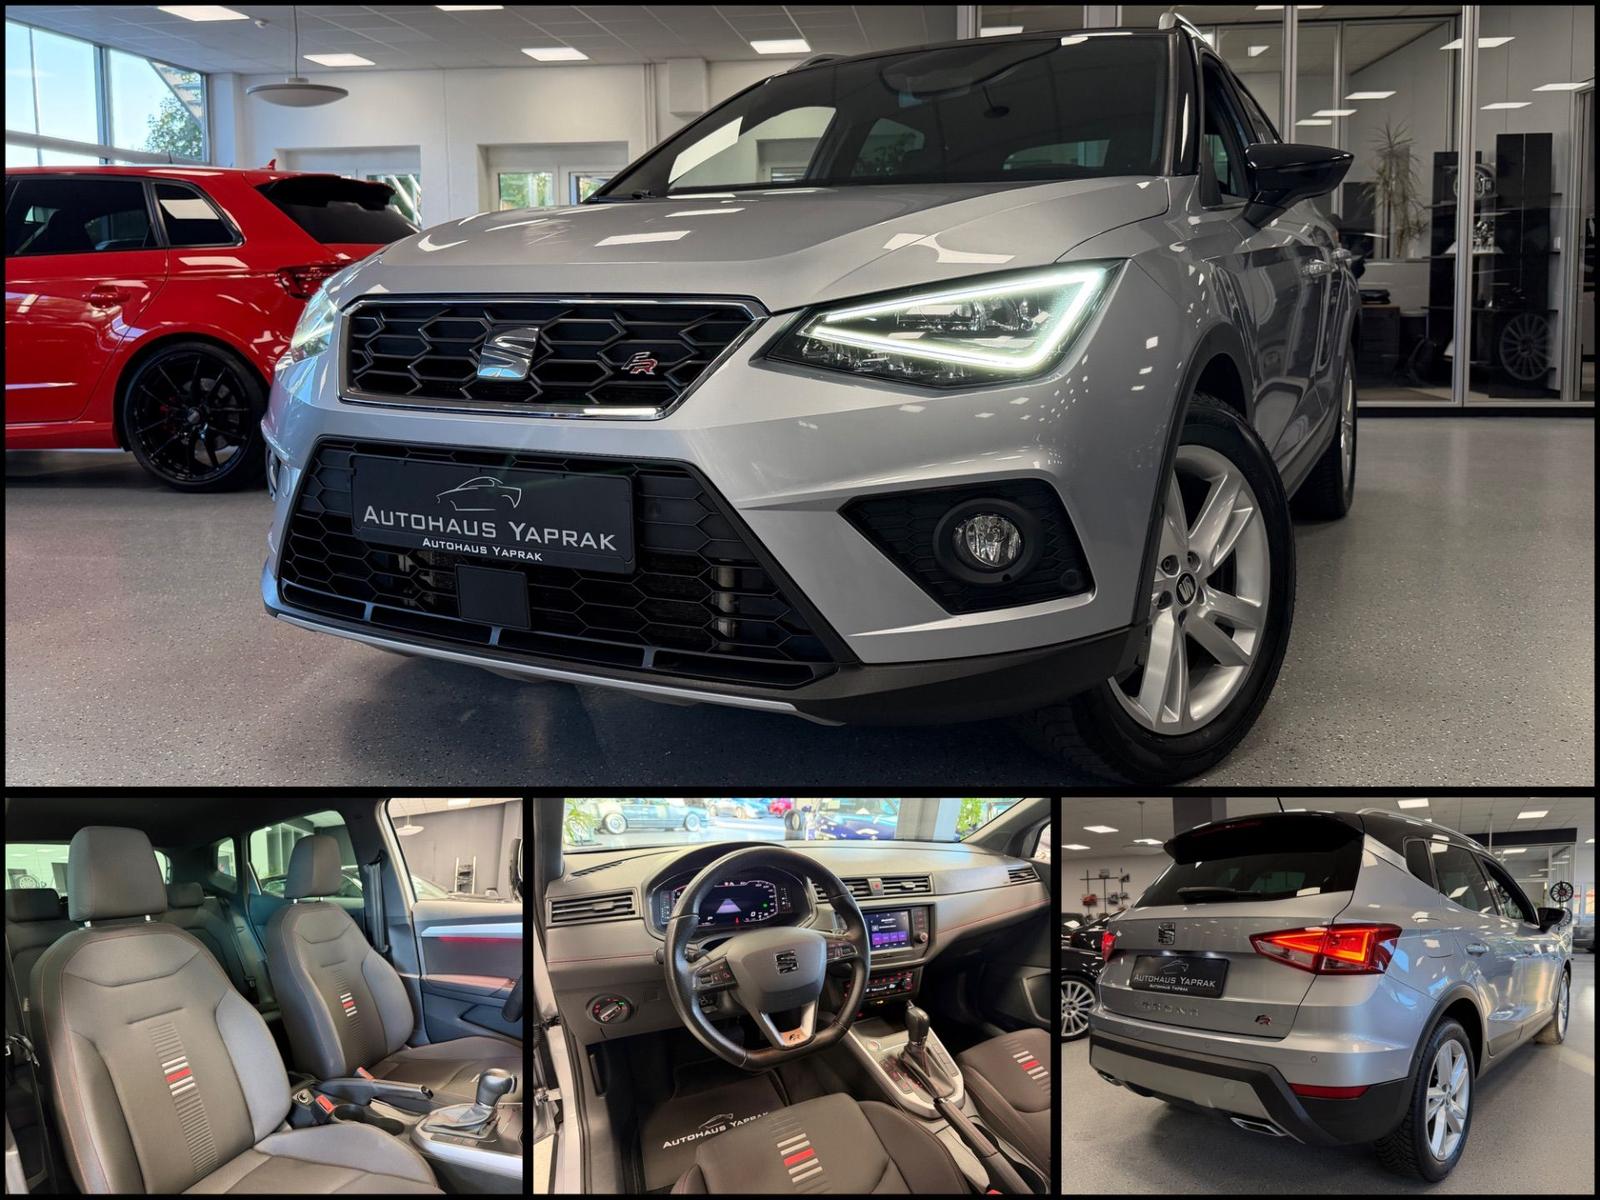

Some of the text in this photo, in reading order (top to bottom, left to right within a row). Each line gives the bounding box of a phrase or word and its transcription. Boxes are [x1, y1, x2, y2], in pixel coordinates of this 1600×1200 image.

[363, 505, 617, 551] AUTOHAUS YAPRAK
[422, 537, 543, 562] AUTOHAUS YAPRAK
[1134, 974, 1216, 988] AUTOHAUS YAPRAK
[662, 1125, 727, 1149] AUTOHAUS
